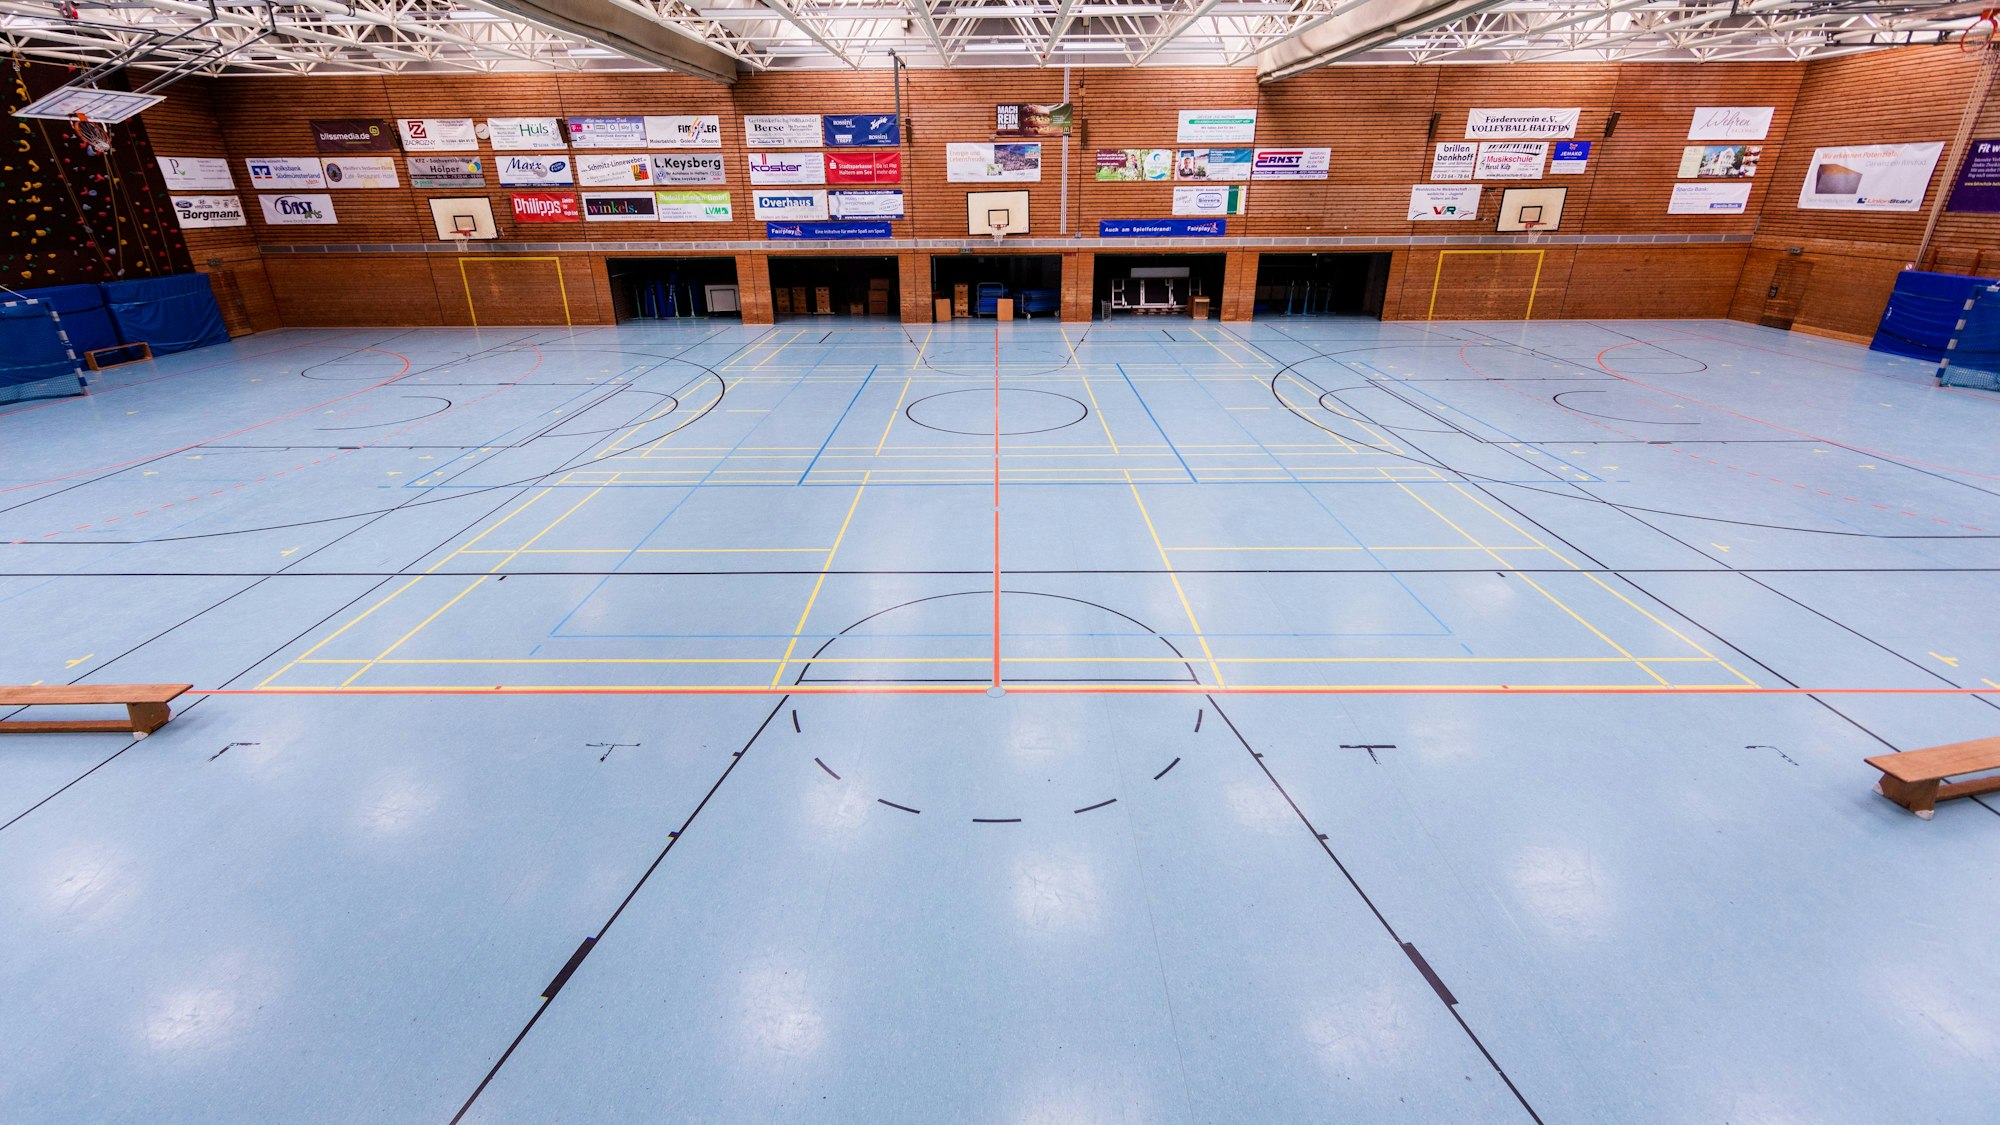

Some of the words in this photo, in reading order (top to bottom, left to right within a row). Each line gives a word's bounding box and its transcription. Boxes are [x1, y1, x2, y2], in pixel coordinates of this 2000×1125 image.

[997, 105, 1018, 114] MACH
[997, 114, 1018, 124] REIN
[1485, 115, 1540, 123] Förderverein
[1541, 115, 1557, 123] e.V.
[519, 123, 549, 136] Hüls
[754, 124, 784, 132] Berse
[1529, 124, 1570, 132] HALTERN
[320, 132, 370, 140] blissmedia.de
[1443, 144, 1470, 152] brillen
[1978, 143, 1991, 154] Fit
[1255, 151, 1304, 168] ERNST
[1437, 153, 1473, 161] benkhoff
[1486, 155, 1533, 163] Musikschule
[506, 157, 541, 173] Marx
[751, 160, 802, 172] köster
[761, 197, 811, 207] Overhaus
[514, 198, 562, 217] Philipps
[705, 206, 721, 215] LVM
[1433, 206, 1457, 215] VR
[177, 209, 242, 221] Borgmann
